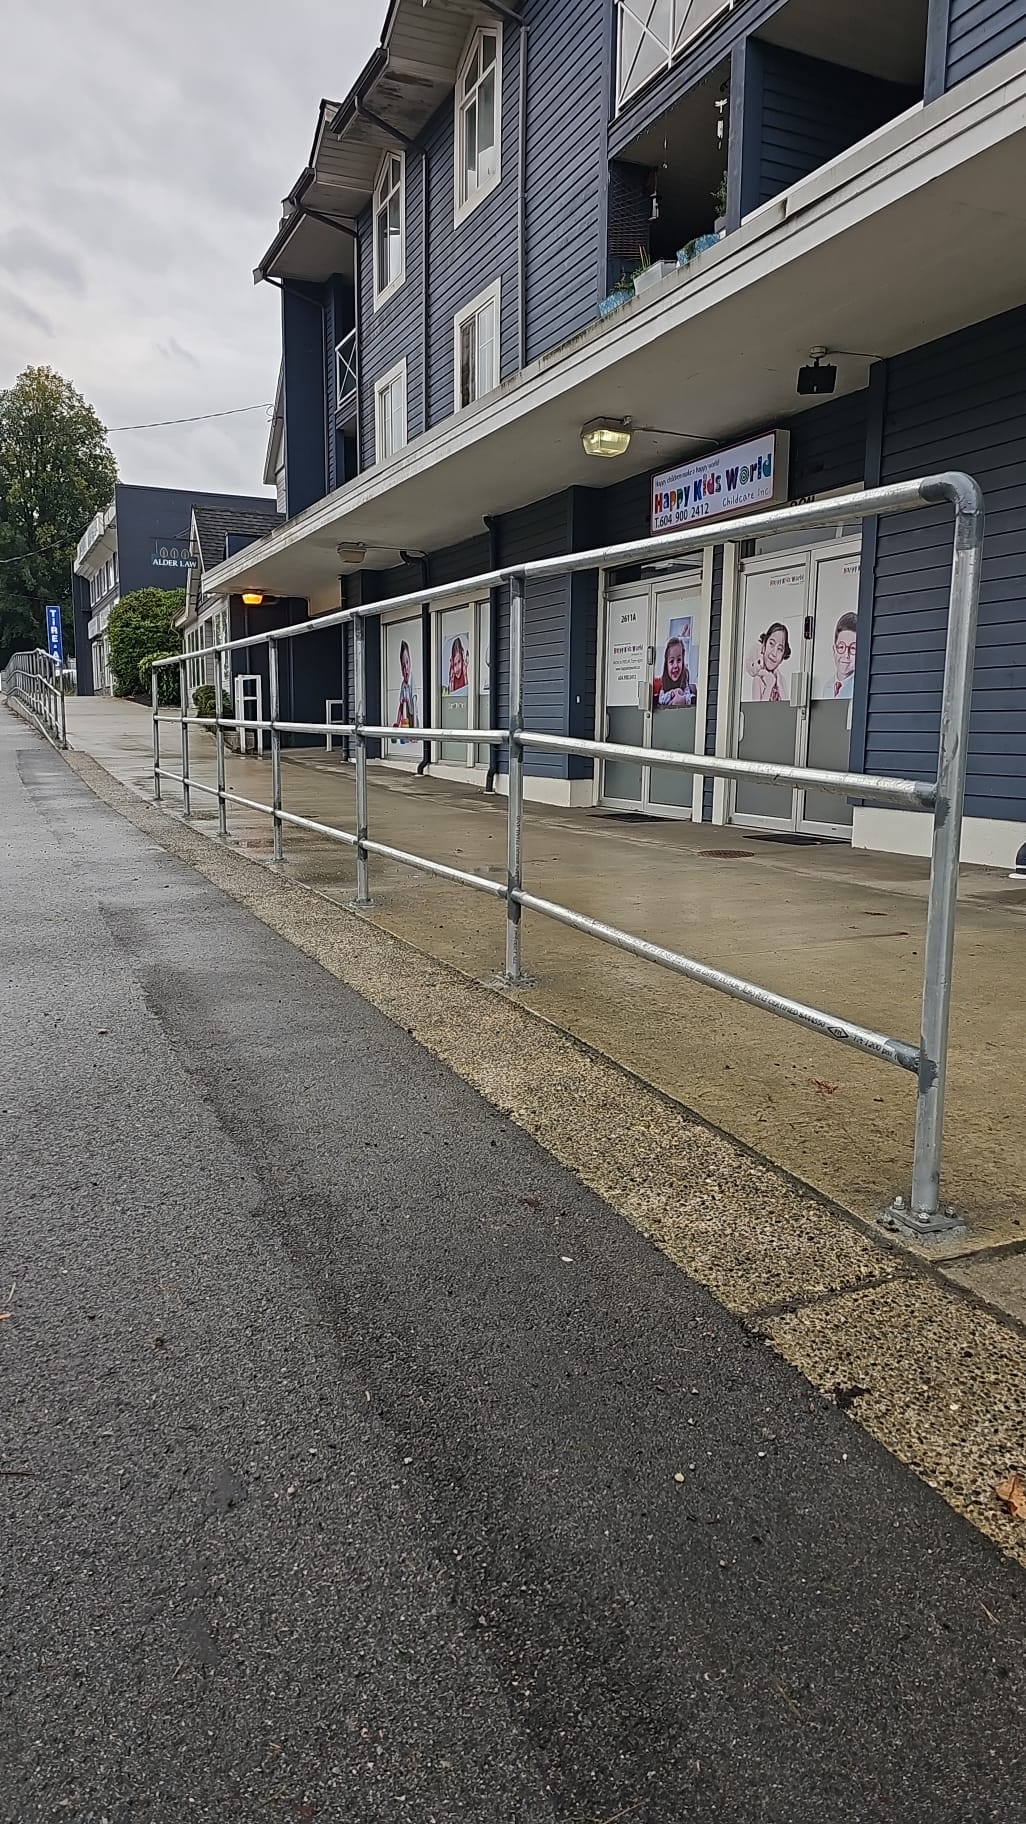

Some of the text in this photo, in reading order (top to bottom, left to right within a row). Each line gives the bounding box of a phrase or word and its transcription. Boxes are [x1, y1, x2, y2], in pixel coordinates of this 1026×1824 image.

[655, 453, 772, 515] Happy Kids World
[722, 487, 769, 507] Childcare Inc
[655, 502, 709, 528] T.604 900 2412
[152, 558, 197, 568] ALDER LAW
[49, 609, 59, 643] TIRE
[620, 612, 637, 624] 2611A
